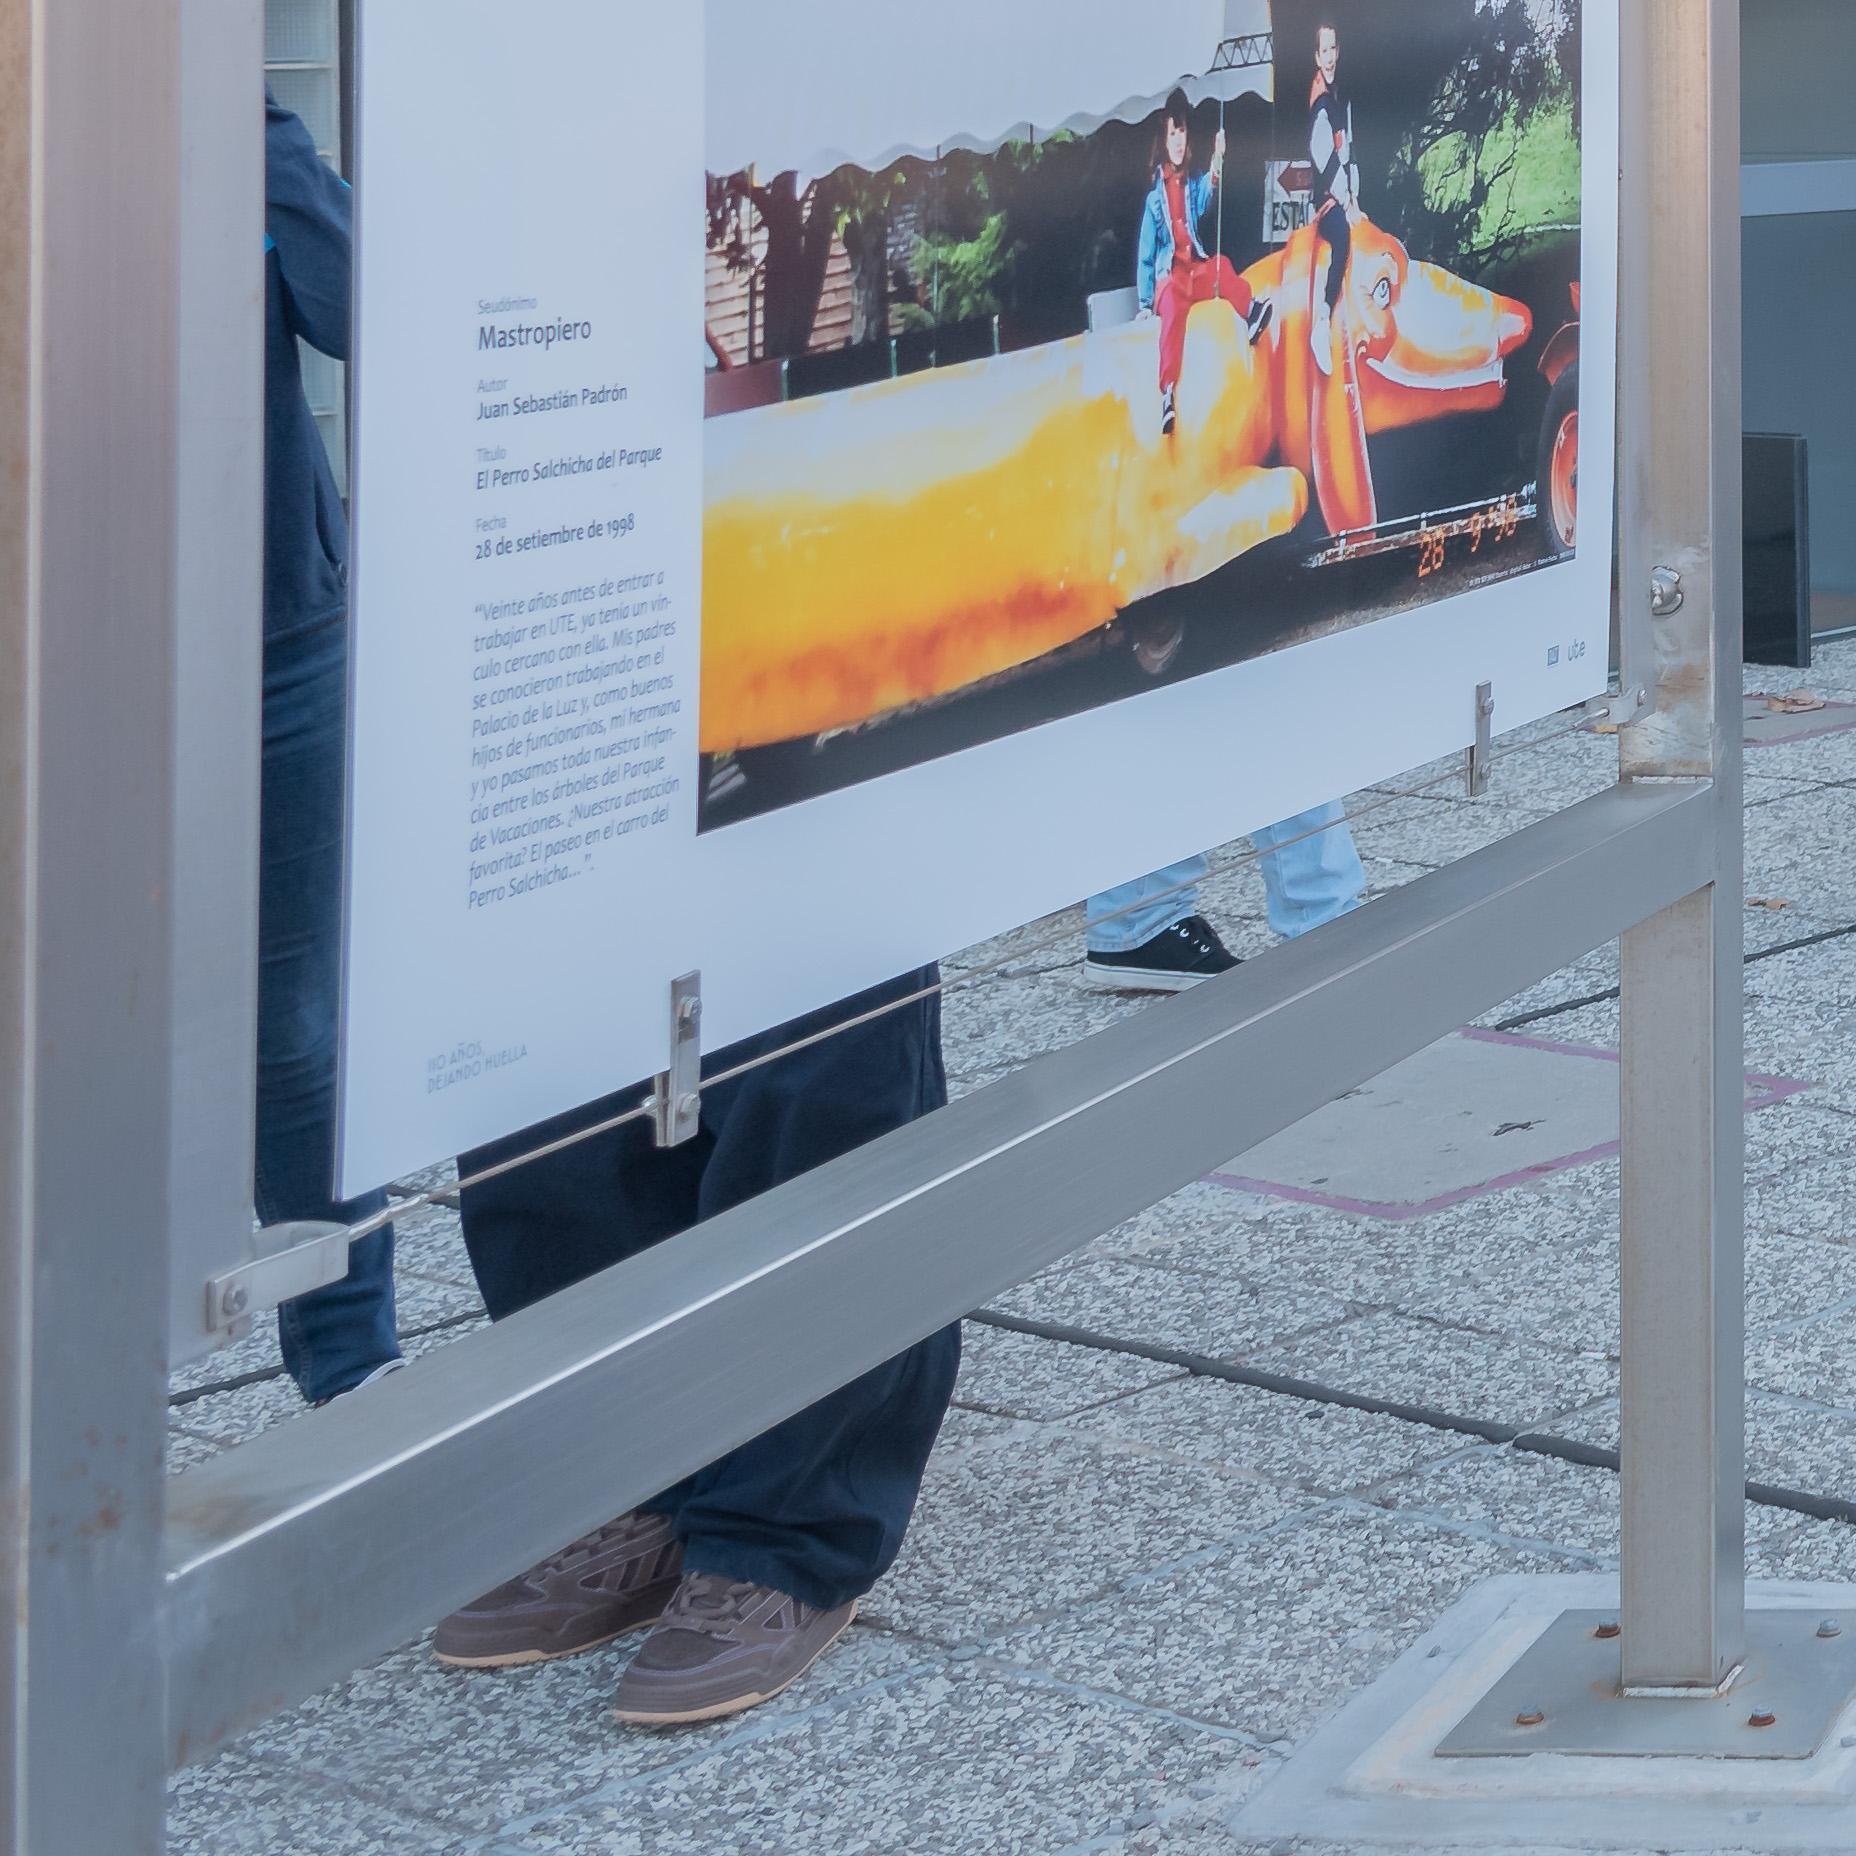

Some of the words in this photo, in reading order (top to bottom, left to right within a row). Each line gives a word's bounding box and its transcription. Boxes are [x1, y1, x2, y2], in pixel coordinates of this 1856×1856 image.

[478, 317, 591, 351] Mastropiero
[476, 377, 508, 393] Autor
[476, 402, 508, 420] Juan
[512, 390, 577, 415] Sebastián
[581, 383, 627, 405] Padrón
[476, 470, 488, 490] El
[492, 468, 528, 487] Perro
[532, 454, 592, 480] Salchicha
[596, 450, 614, 470] del
[618, 447, 662, 468] Parque
[475, 539, 491, 559] 28
[495, 536, 512, 555] de
[516, 524, 583, 551] setiembre
[587, 518, 602, 537] de
[606, 511, 634, 537] 1998
[476, 515, 506, 532] Fecha
[528, 592, 557, 612] años
[561, 586, 595, 605] antes
[616, 573, 653, 593] entrar
[473, 626, 528, 652] trabajar
[599, 602, 629, 624] tenía
[473, 659, 501, 680] culo
[504, 650, 554, 673] cercano
[558, 644, 580, 661] con
[611, 628, 632, 648] Mis
[635, 621, 676, 648] padres
[490, 675, 562, 705] conocieron
[566, 655, 633, 686] trabajando
[472, 711, 519, 737] Palacio
[556, 698, 577, 716] Luz
[593, 687, 627, 706] como
[630, 675, 673, 697] buenos
[472, 744, 502, 768] hijos
[525, 719, 607, 757] funcionarios,
[629, 699, 680, 724] hermana
[501, 759, 558, 792] pasamos
[562, 747, 590, 769] toda
[594, 737, 640, 761] nuestra
[470, 803, 488, 823] cia
[492, 796, 528, 817] entre
[531, 788, 548, 806] los
[552, 774, 598, 800] árboles
[601, 764, 619, 786] del
[623, 756, 664, 780] Parque
[624, 775, 679, 806] atracción
[468, 847, 527, 886] favorita?
[544, 835, 580, 862] paseo
[616, 814, 648, 835] carro
[650, 802, 668, 824] del
[468, 886, 505, 909] Perro
[484, 1044, 528, 1072] HUELLA
